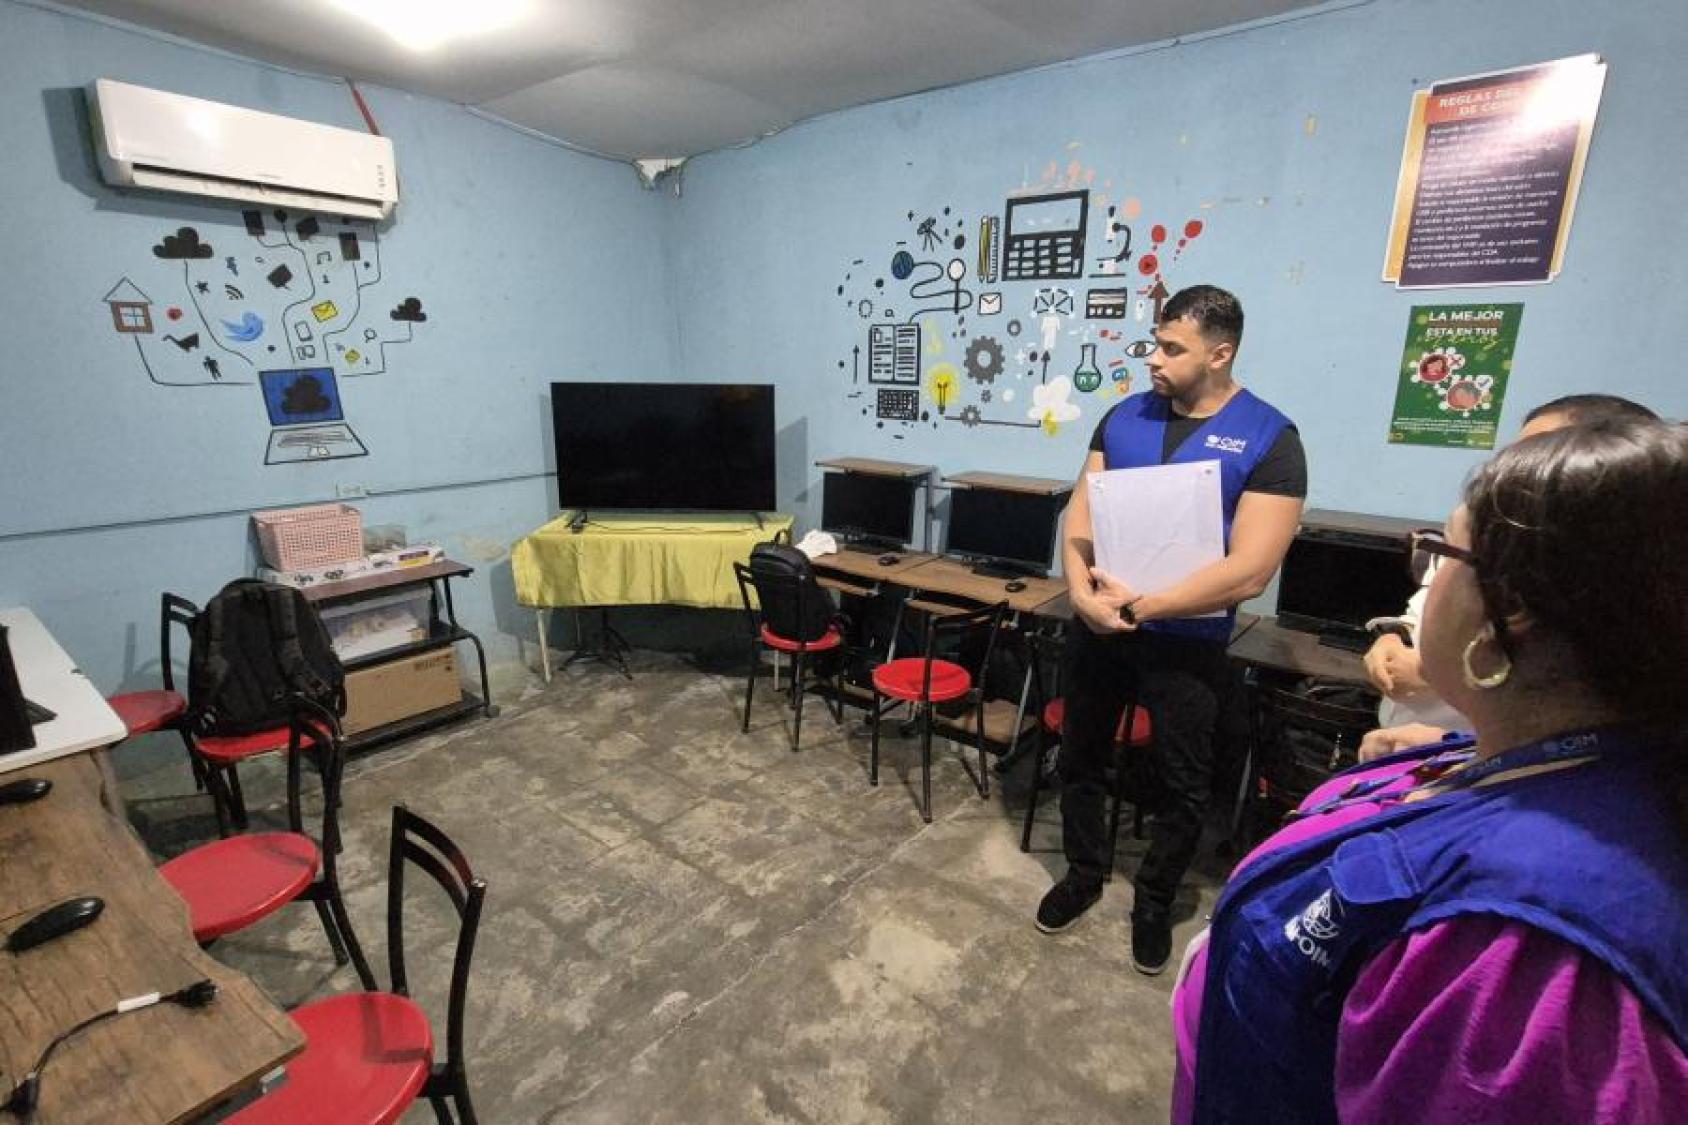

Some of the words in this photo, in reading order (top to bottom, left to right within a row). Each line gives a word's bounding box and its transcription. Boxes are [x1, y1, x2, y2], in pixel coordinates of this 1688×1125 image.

[1439, 91, 1492, 108] REGLAS
[1429, 310, 1447, 321] LA
[1451, 310, 1504, 320] MEJOR
